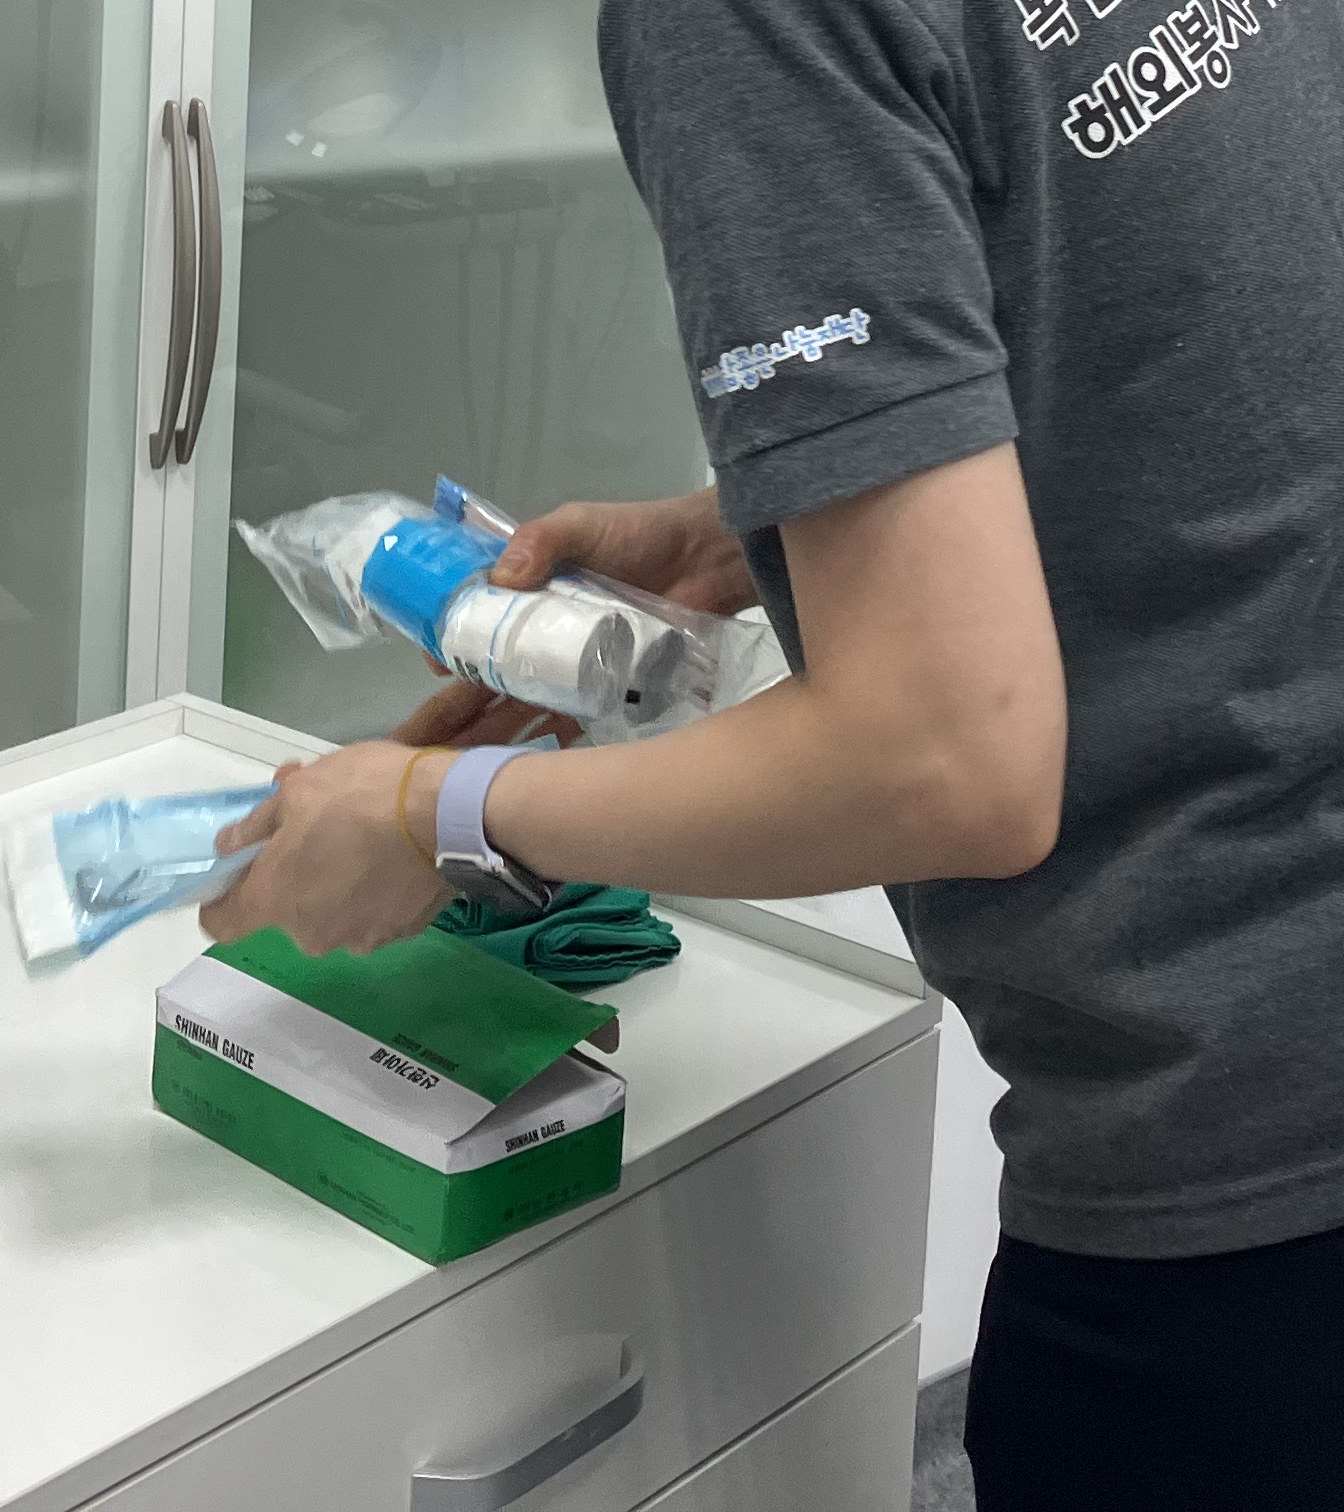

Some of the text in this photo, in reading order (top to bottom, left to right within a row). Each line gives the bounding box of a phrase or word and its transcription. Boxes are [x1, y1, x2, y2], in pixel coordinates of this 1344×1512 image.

[175, 1014, 219, 1052] SHINHAN
[222, 1038, 255, 1070] GAUZE
[504, 1119, 565, 1153] SHINHAN GAUZE
